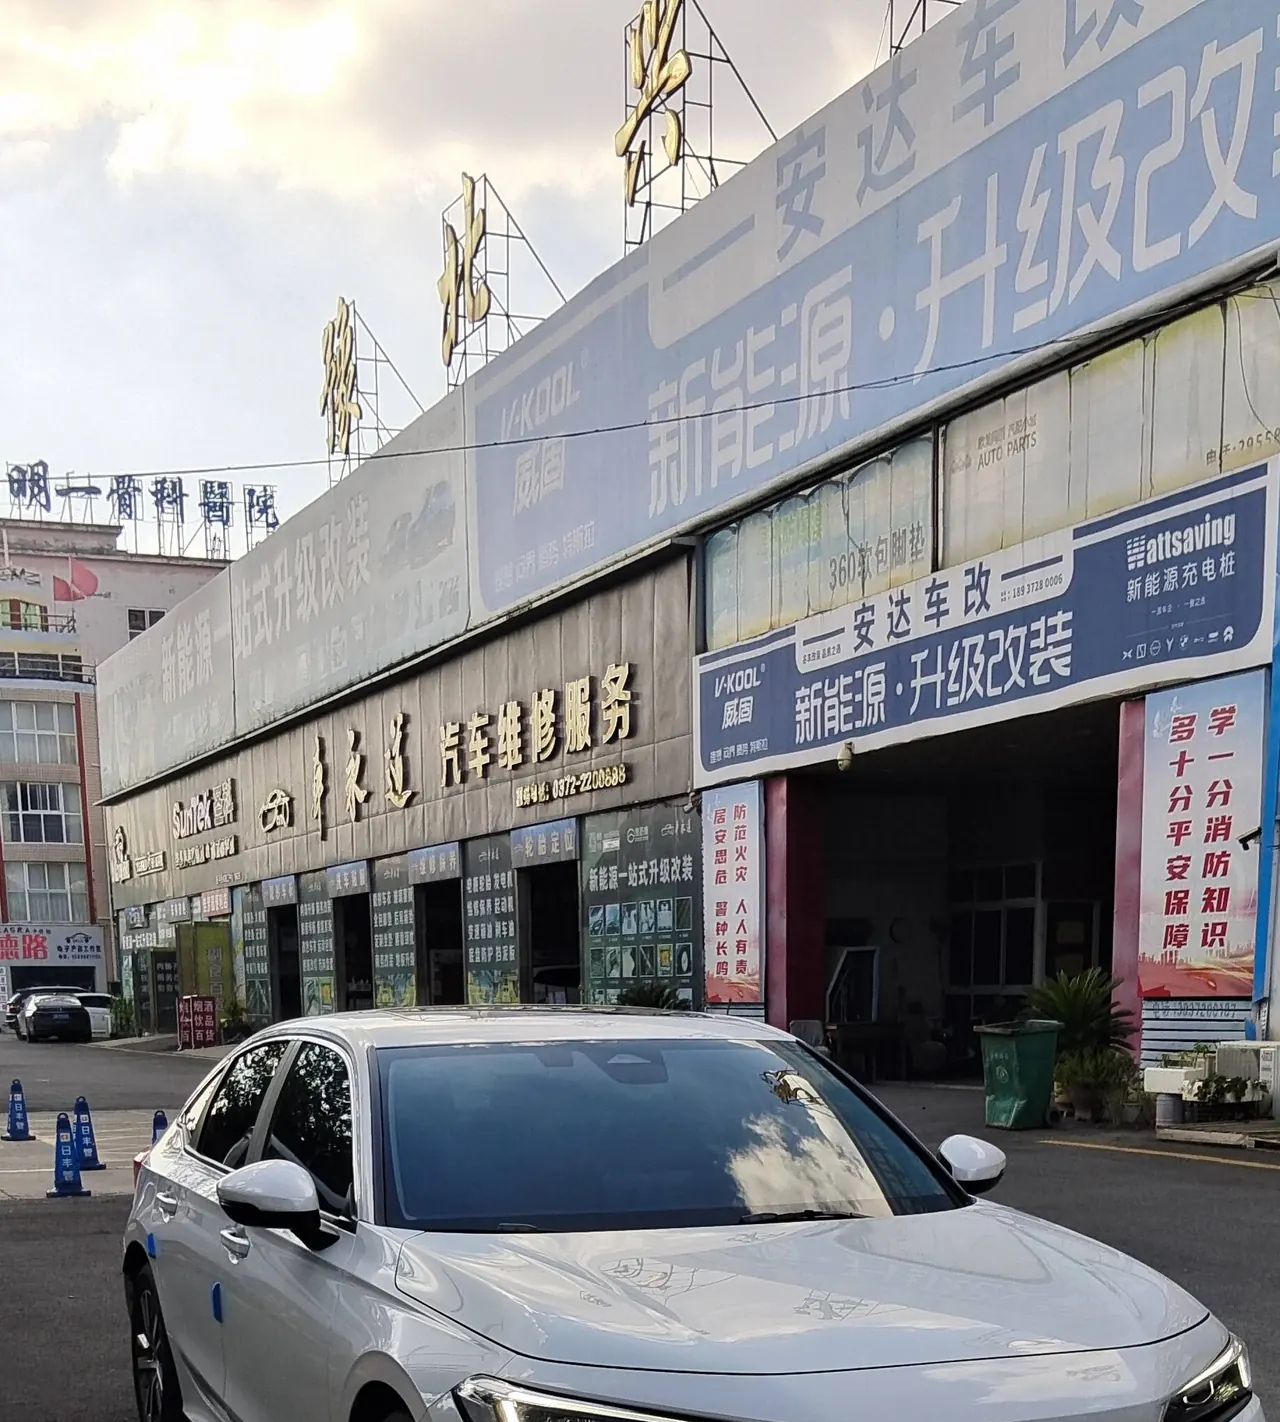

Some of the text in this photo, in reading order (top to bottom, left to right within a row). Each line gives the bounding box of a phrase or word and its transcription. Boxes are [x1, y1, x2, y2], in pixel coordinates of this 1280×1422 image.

[649, 26, 1280, 519] 新能源·升级改
[978, 447, 1003, 471] AUTO
[1007, 432, 1036, 457] PARTS
[1126, 512, 1236, 571] Wattsaving
[1126, 550, 1236, 603] 新能源充电桩
[853, 561, 991, 653] 安达车改
[1012, 584, 1026, 599] 189
[1026, 579, 1044, 596] 3728
[721, 696, 754, 730] 威固
[795, 610, 1073, 744] 新能源·升级改装
[440, 662, 631, 787] 汽车维修服务
[589, 853, 693, 892] 新能源一站式升级改装
[1163, 714, 1197, 950] 多十分平安保障
[1201, 704, 1237, 949] 学一分消防知识
[713, 808, 728, 977] 居安思危 警钟长鸣
[733, 804, 748, 975] 防范火灾 人人有责
[195, 1029, 215, 1041] 百货
